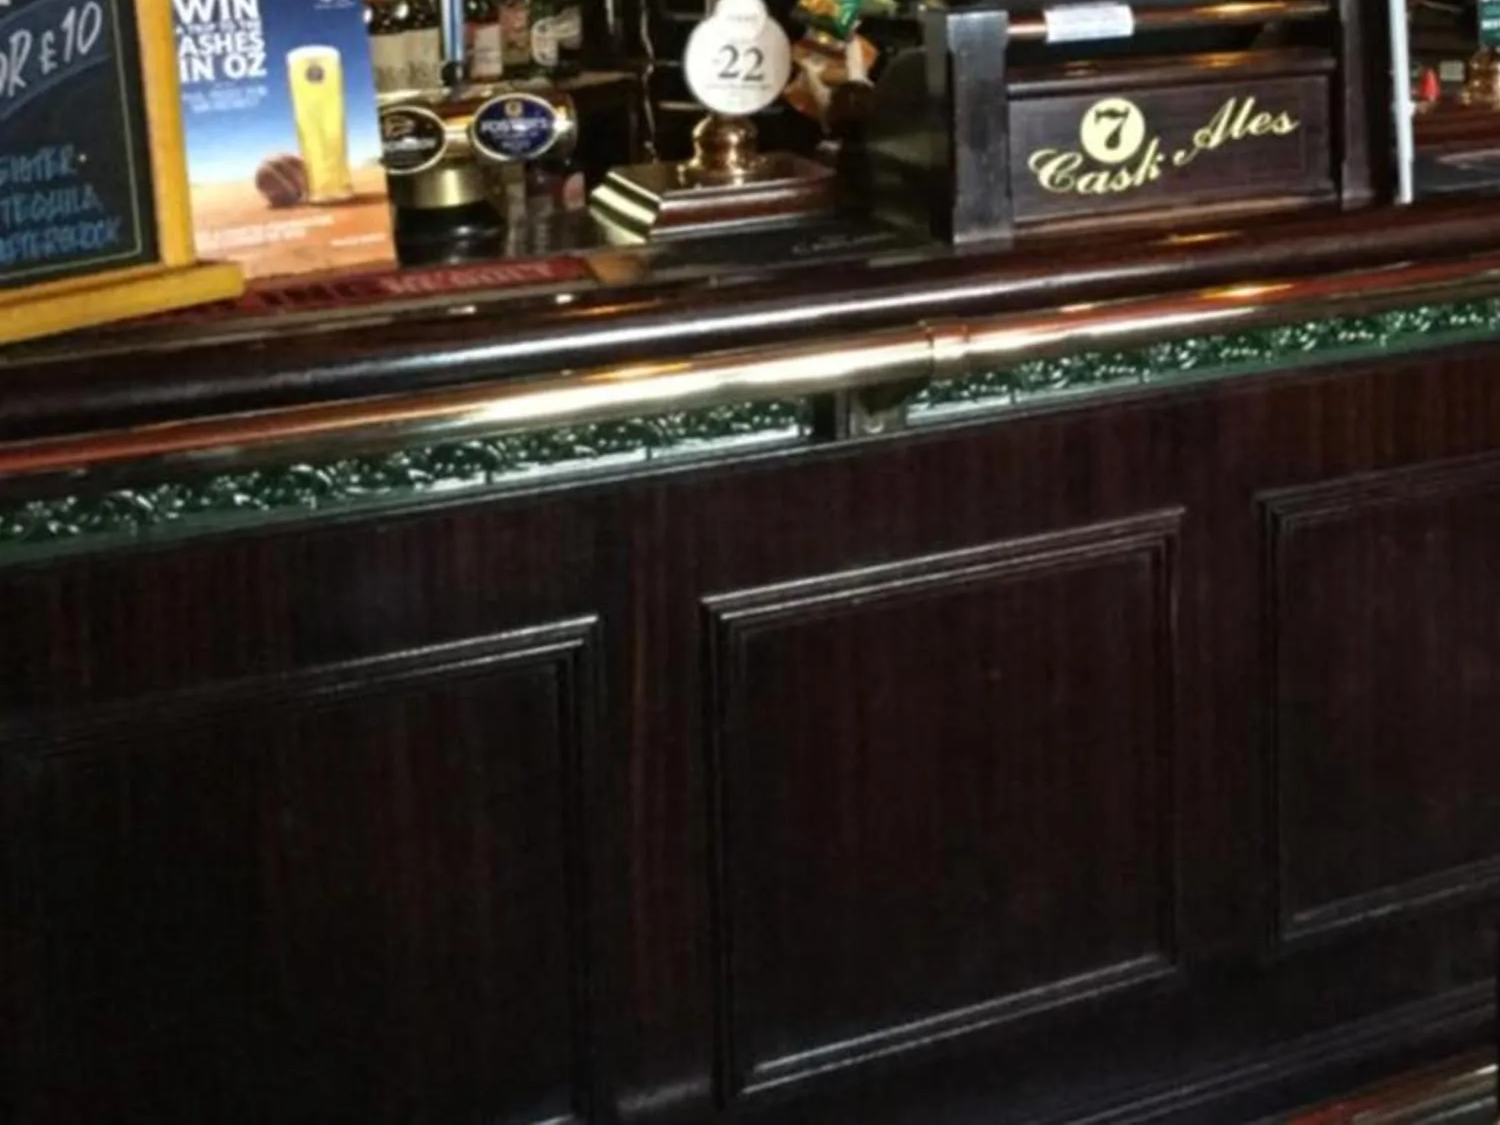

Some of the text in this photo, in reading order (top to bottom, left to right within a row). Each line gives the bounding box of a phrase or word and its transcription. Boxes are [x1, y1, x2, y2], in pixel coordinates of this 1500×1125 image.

[179, 32, 266, 57] ASHES
[718, 44, 765, 82] 22
[180, 51, 268, 83] IN OZ
[1028, 96, 1301, 195] Cask Ales
[1094, 106, 1131, 150] 7
